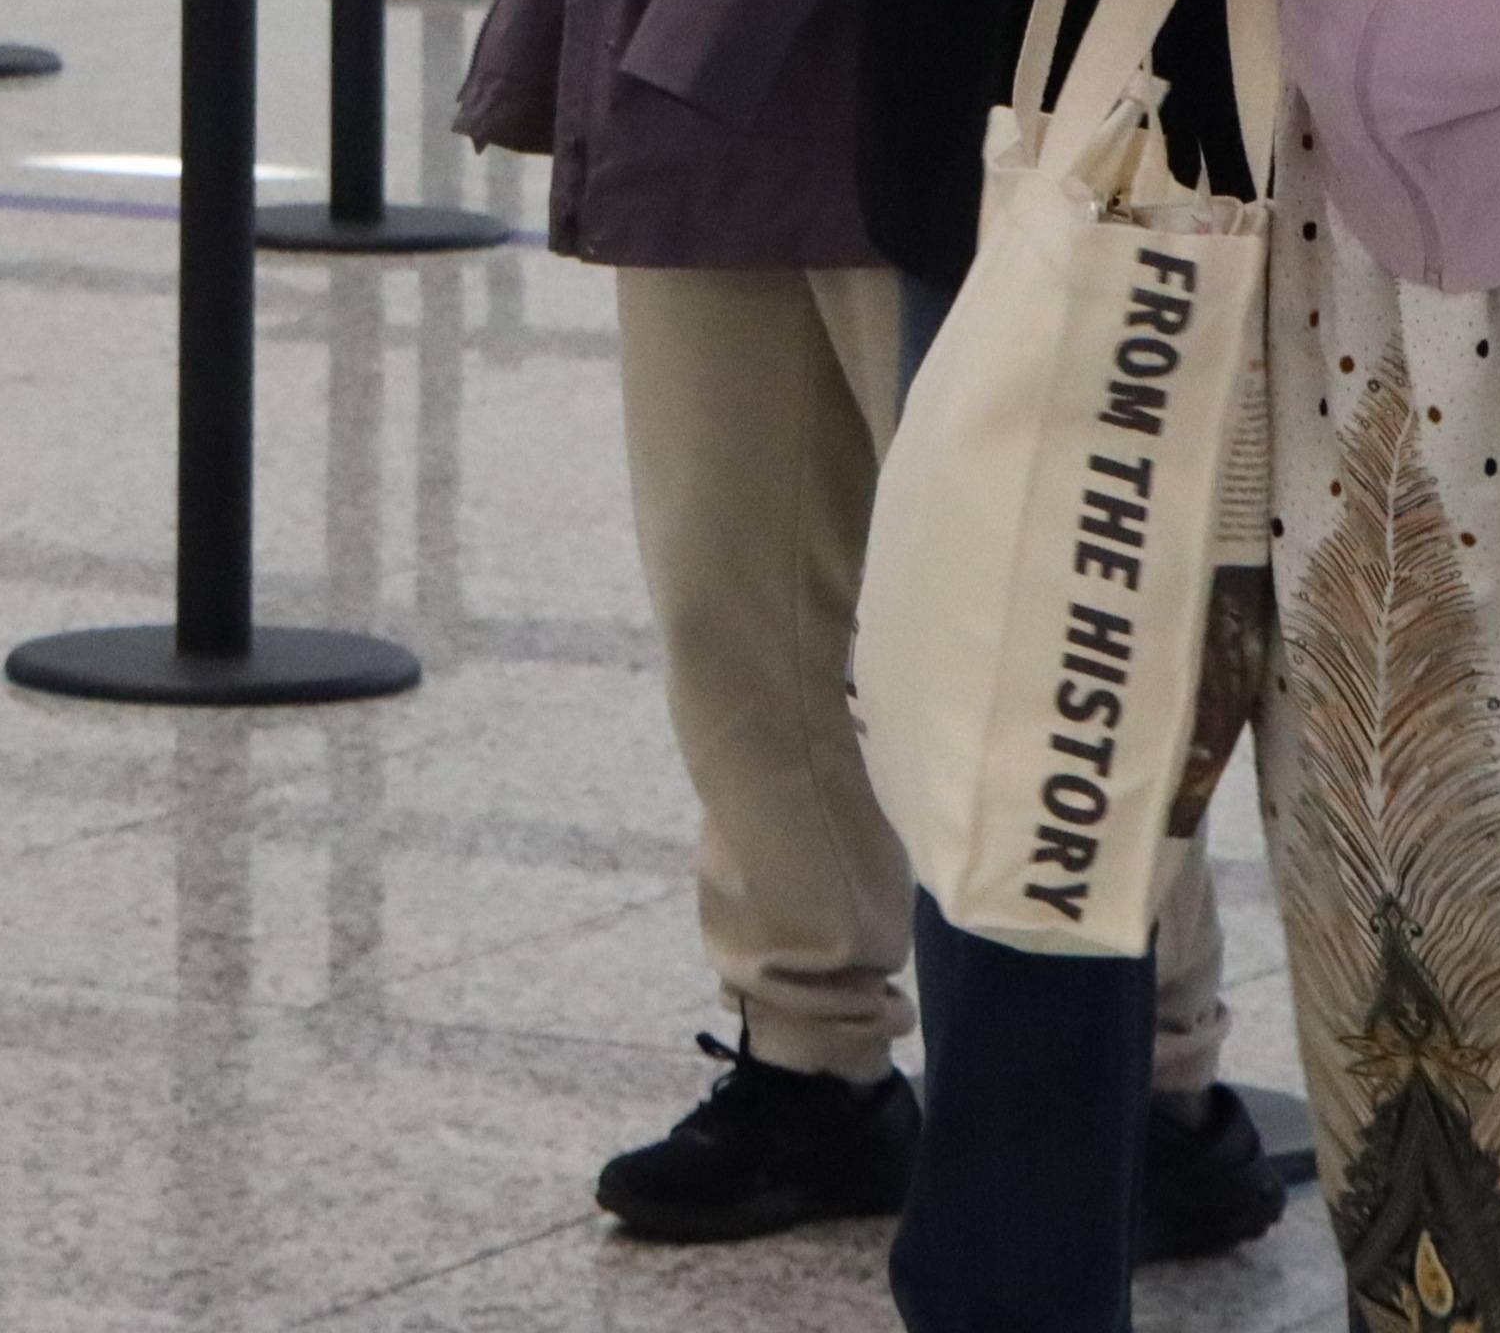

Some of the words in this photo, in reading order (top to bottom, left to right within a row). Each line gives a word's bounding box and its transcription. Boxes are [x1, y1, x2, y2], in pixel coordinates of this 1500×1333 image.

[1098, 247, 1198, 437] FROM
[1072, 452, 1154, 593] THE
[1023, 601, 1134, 924] HISTORY
